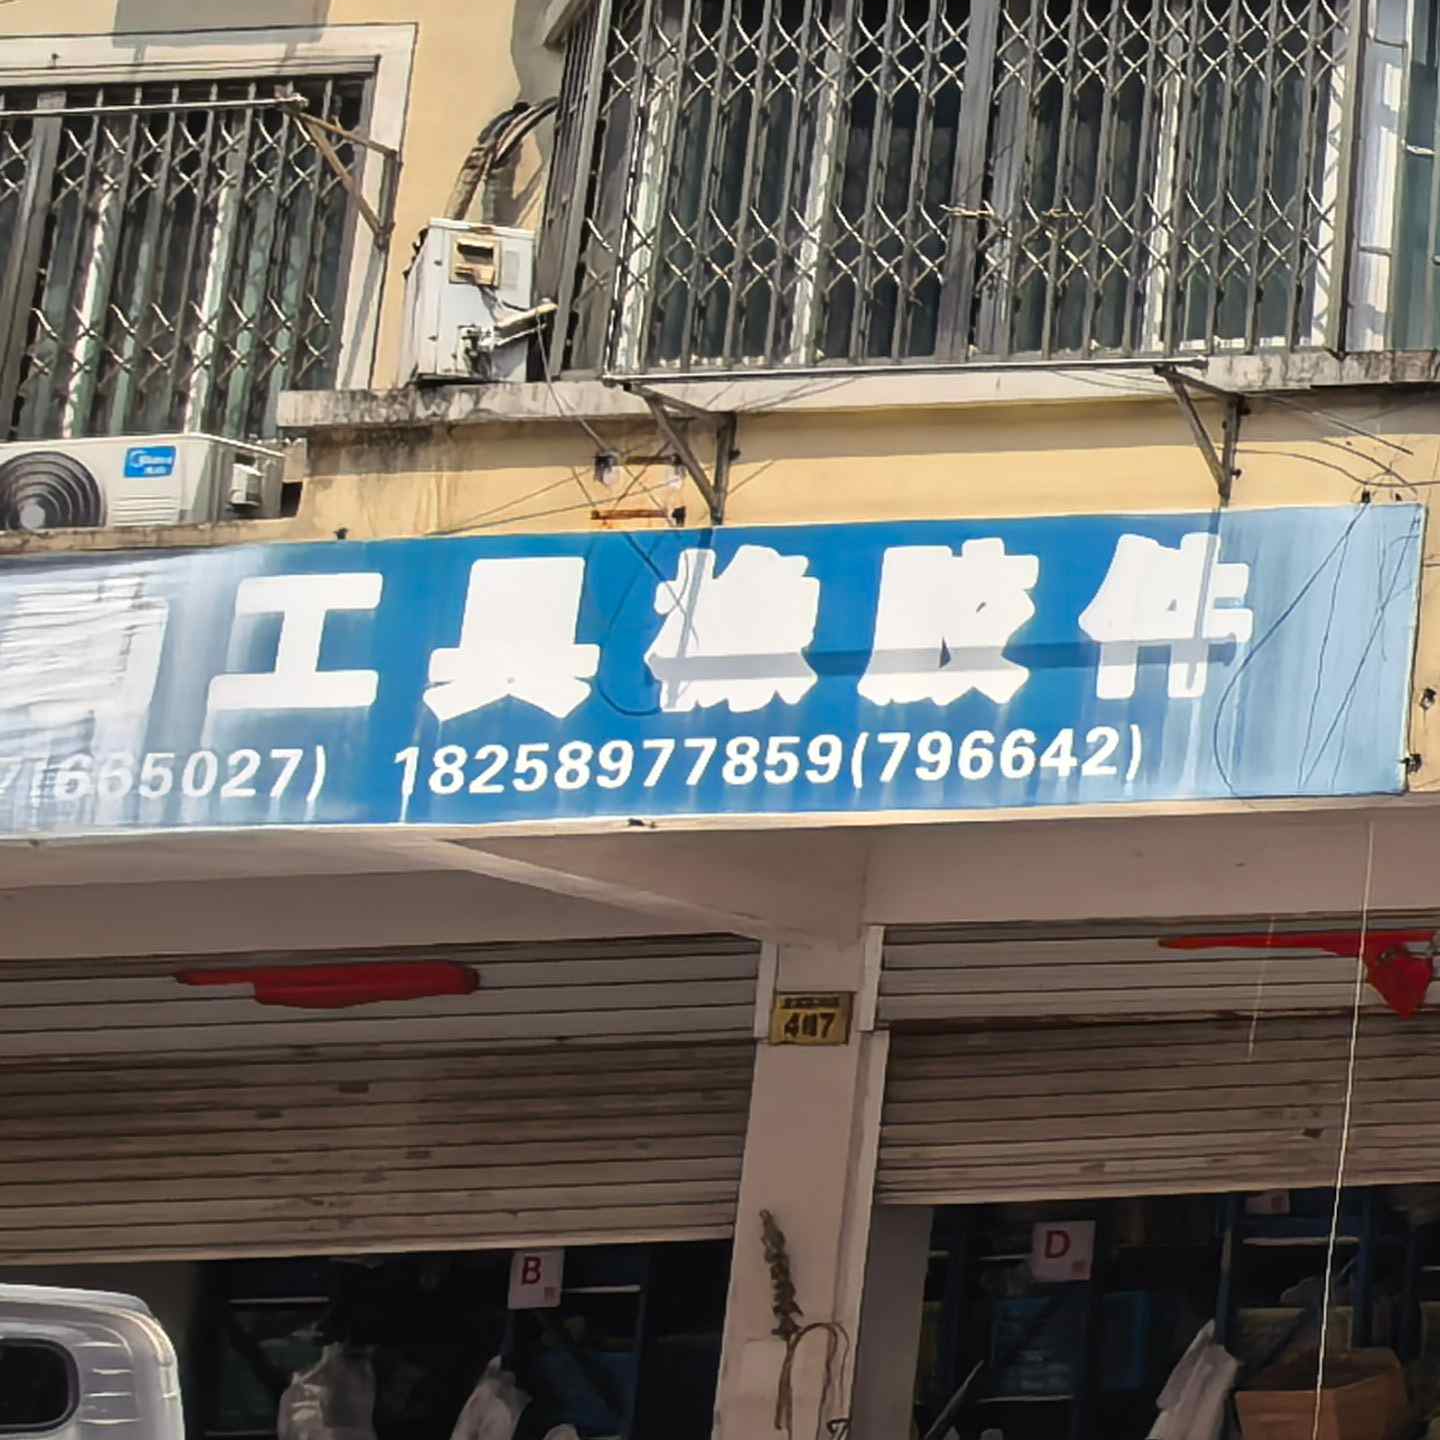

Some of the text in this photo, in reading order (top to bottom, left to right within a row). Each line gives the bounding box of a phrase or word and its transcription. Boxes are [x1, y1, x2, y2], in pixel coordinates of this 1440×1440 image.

[395, 725, 1144, 801] 18258977859(796642)
[1043, 1229, 1072, 1260] D
[520, 1256, 543, 1286] B
